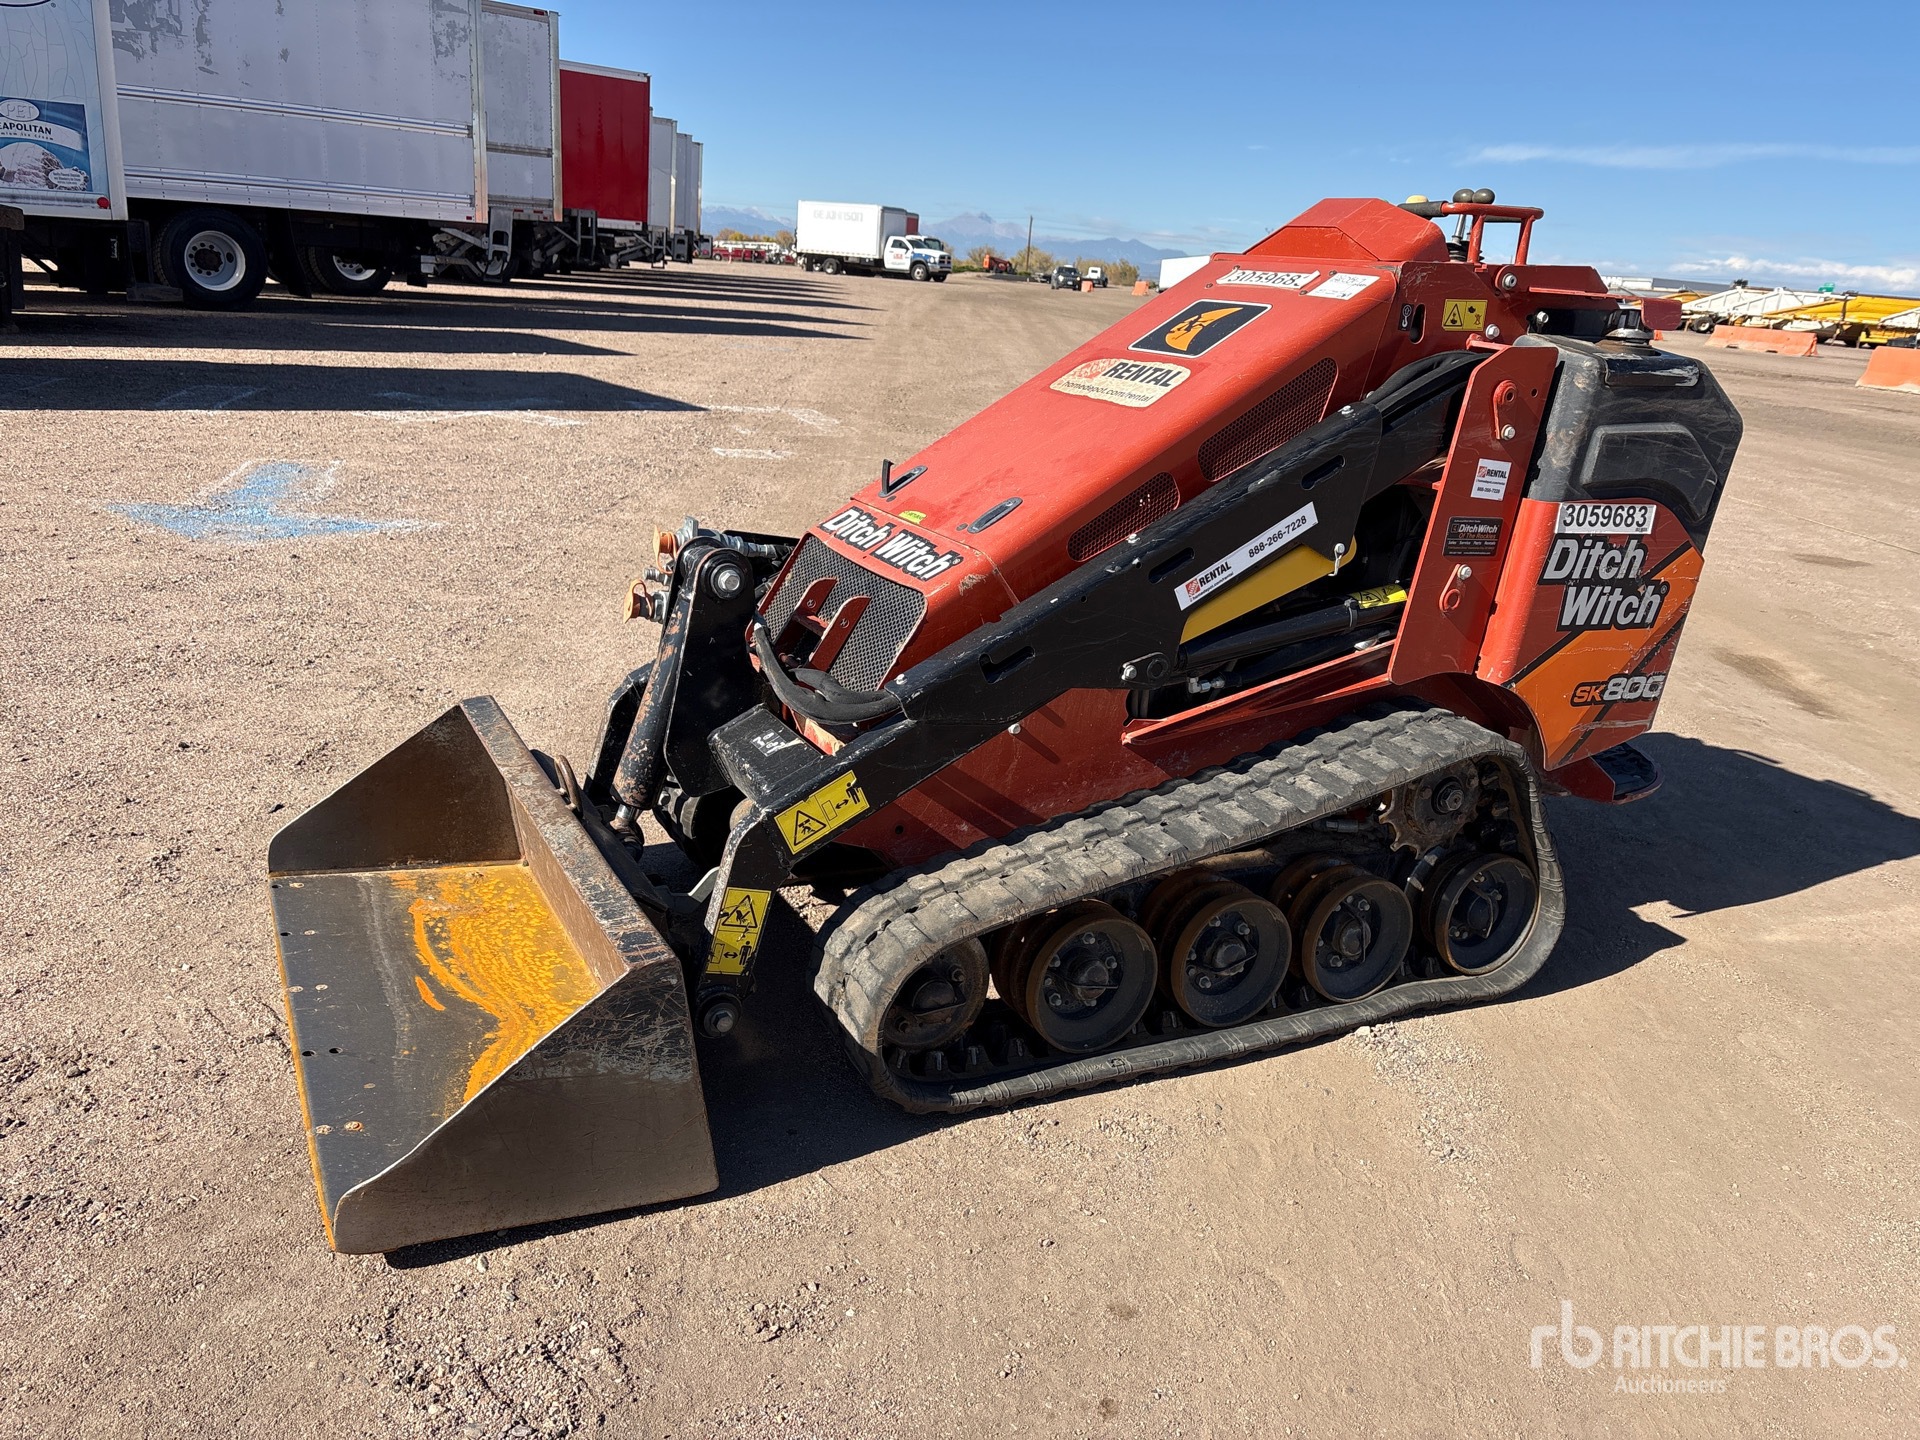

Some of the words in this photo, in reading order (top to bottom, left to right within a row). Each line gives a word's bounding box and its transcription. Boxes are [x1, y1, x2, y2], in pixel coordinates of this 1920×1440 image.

[6, 103, 34, 118] PET
[1101, 361, 1183, 388] RENTAL
[1487, 469, 1507, 478] RENTAL
[1458, 524, 1478, 533] Ditch
[1478, 524, 1498, 534] Witch
[1562, 504, 1649, 528] 3059683
[821, 507, 892, 550] Ditch
[875, 531, 954, 580] Witch
[1199, 561, 1232, 587] RENTAL
[1247, 515, 1308, 559] 888-266-7228
[1543, 538, 1646, 580] Ditch
[1561, 585, 1663, 627] Witch
[1573, 675, 1666, 703] SK800
